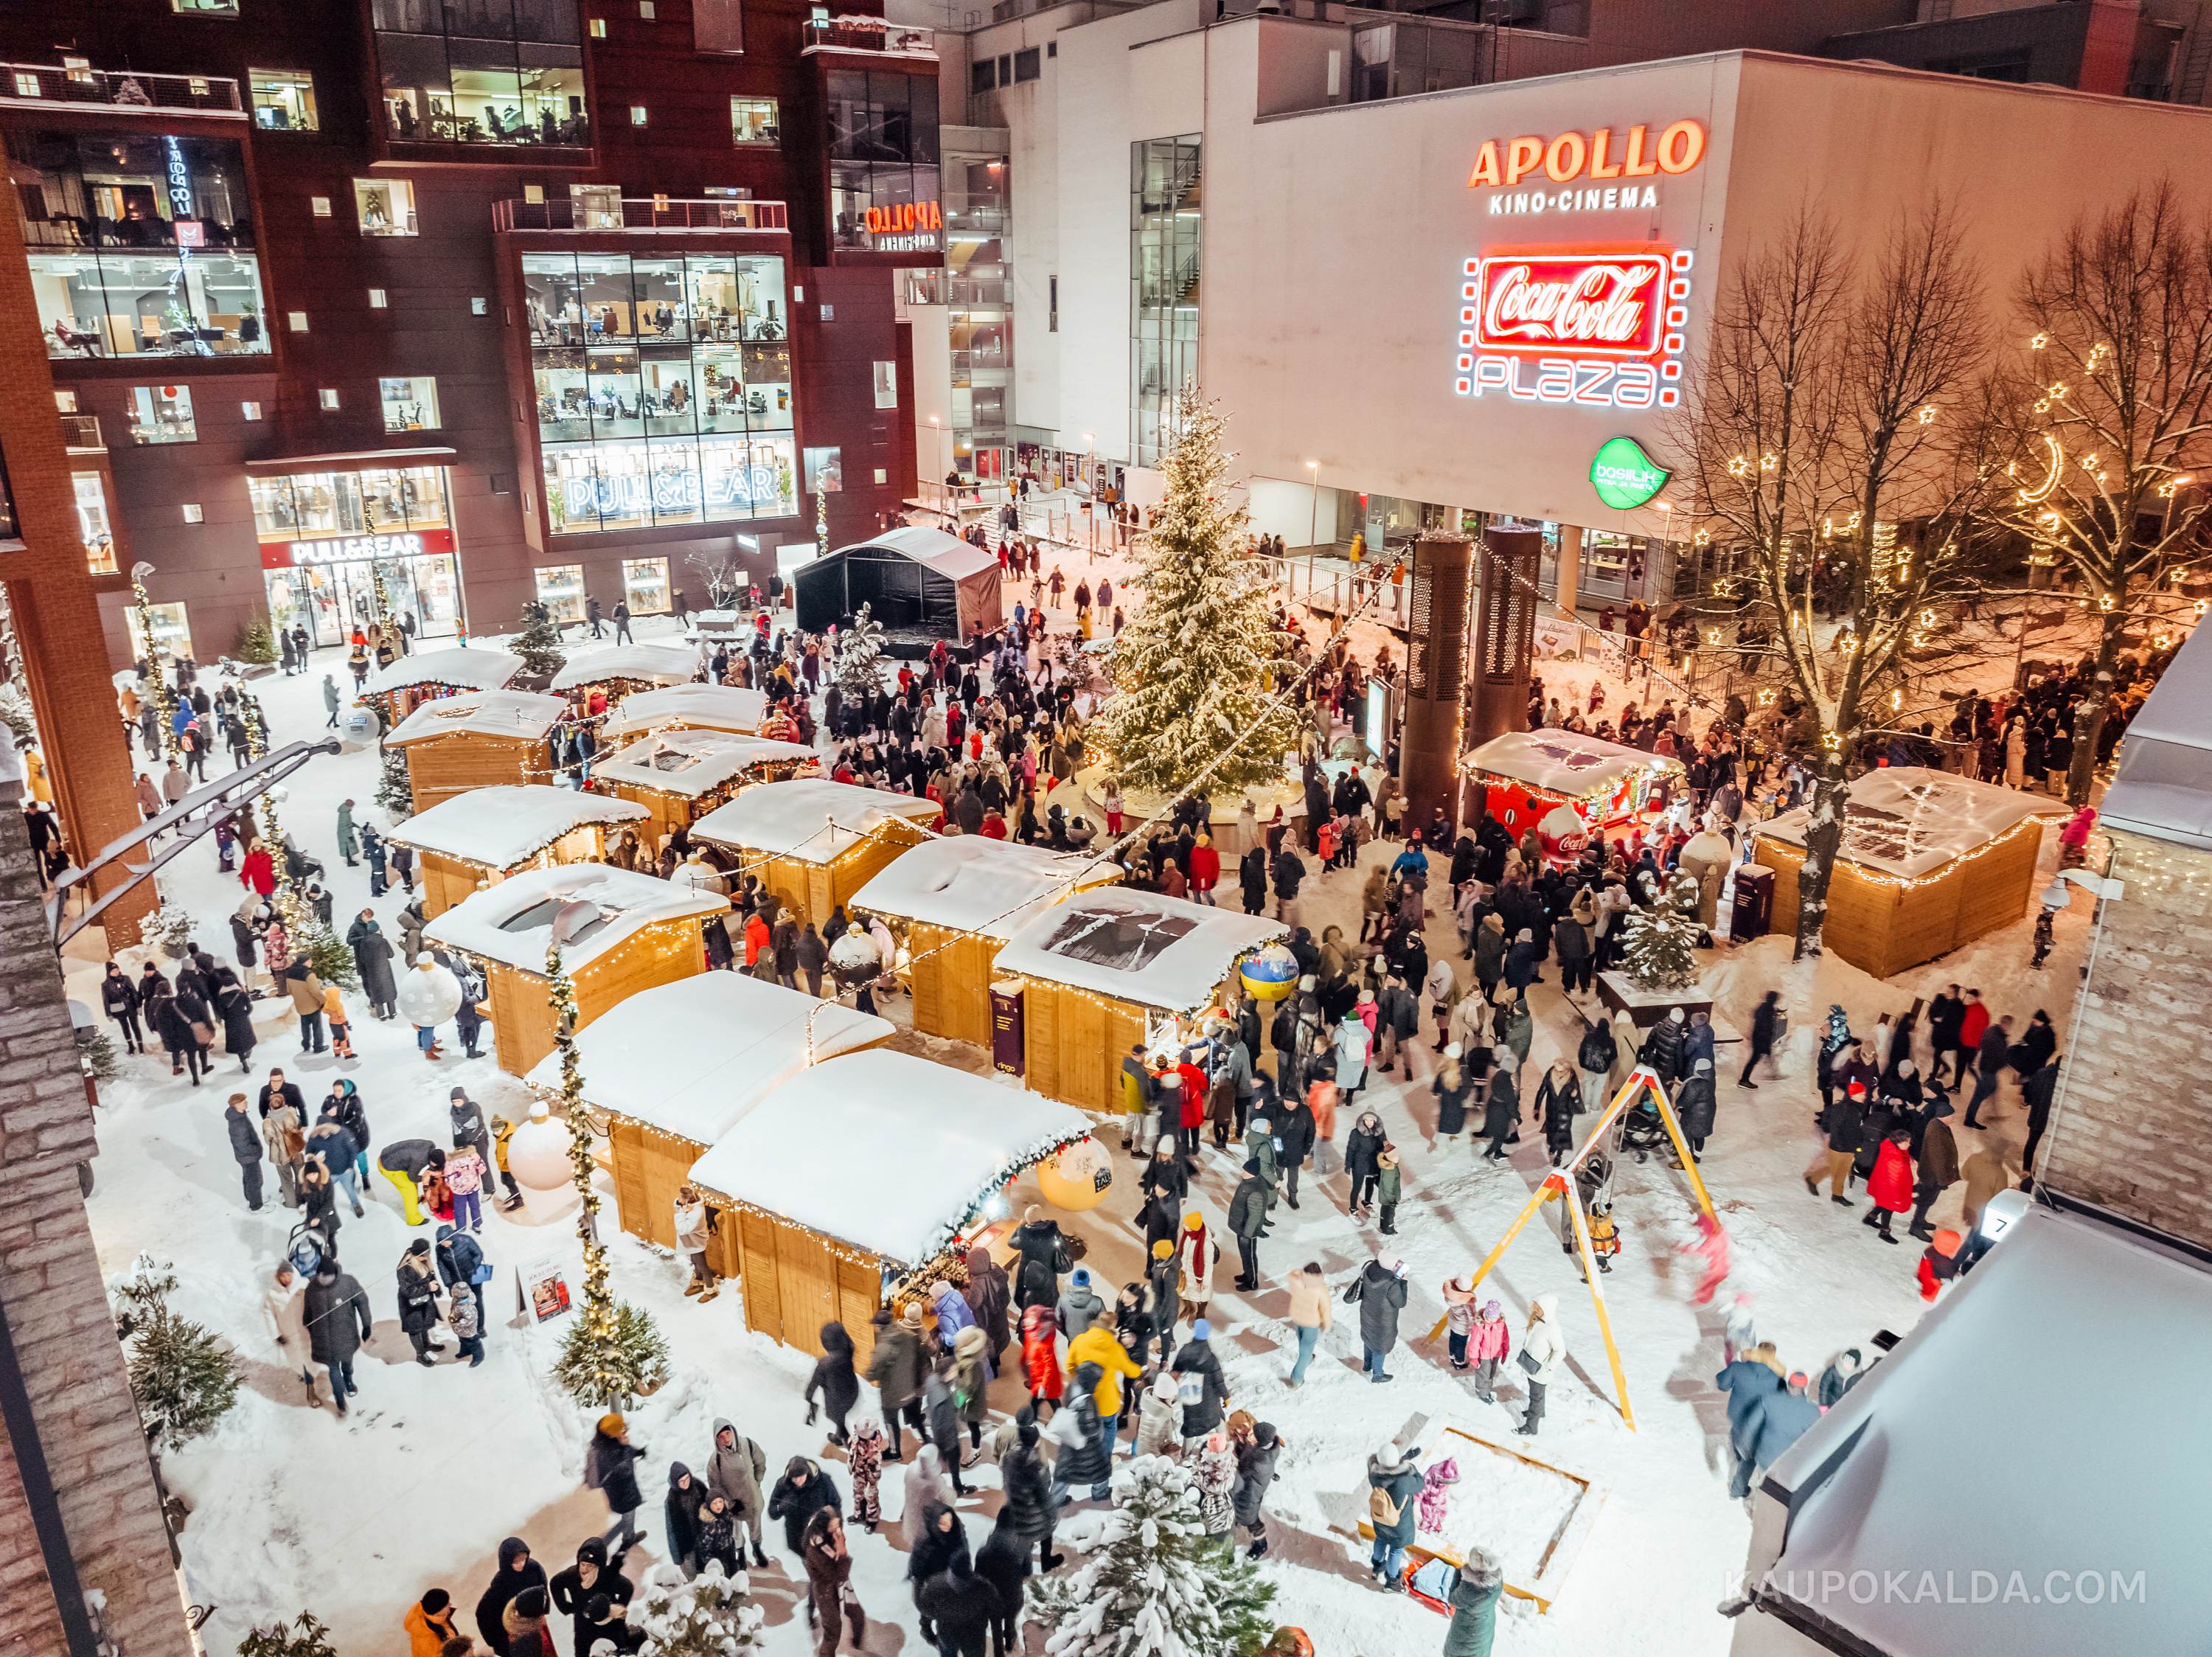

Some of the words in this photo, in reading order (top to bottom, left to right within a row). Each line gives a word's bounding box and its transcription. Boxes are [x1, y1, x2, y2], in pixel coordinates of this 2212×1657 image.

[1467, 119, 1706, 188] APOLLO
[1486, 265, 1658, 341] Coca-Cola
[567, 466, 774, 515] PULL&BEAR
[291, 535, 422, 564] PULL&BEAR
[998, 1062, 1015, 1072] ringo
[1995, 1218, 2008, 1232] 7
